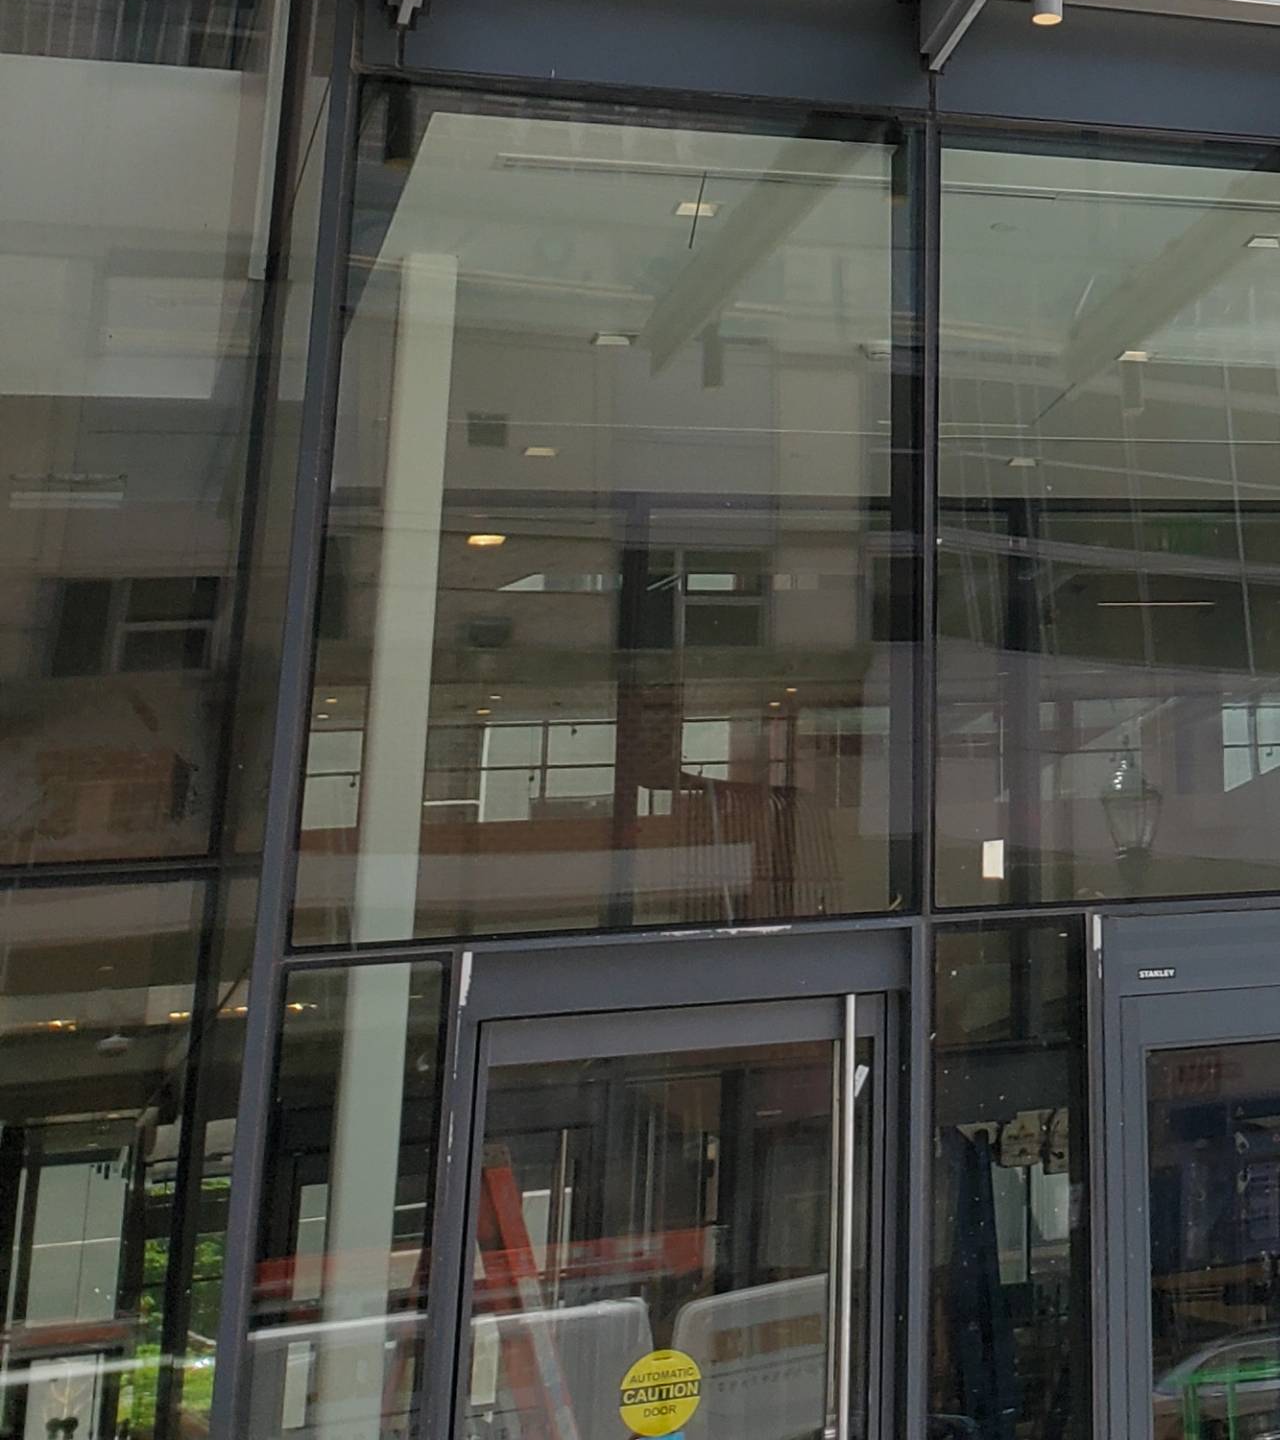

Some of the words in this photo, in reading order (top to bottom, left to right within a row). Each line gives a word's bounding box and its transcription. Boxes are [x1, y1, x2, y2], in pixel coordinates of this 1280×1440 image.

[1138, 968, 1175, 979] STANLEY
[628, 1366, 696, 1385] AUTOMATIC
[622, 1380, 699, 1405] CAUTION
[643, 1404, 677, 1418] DOOR
